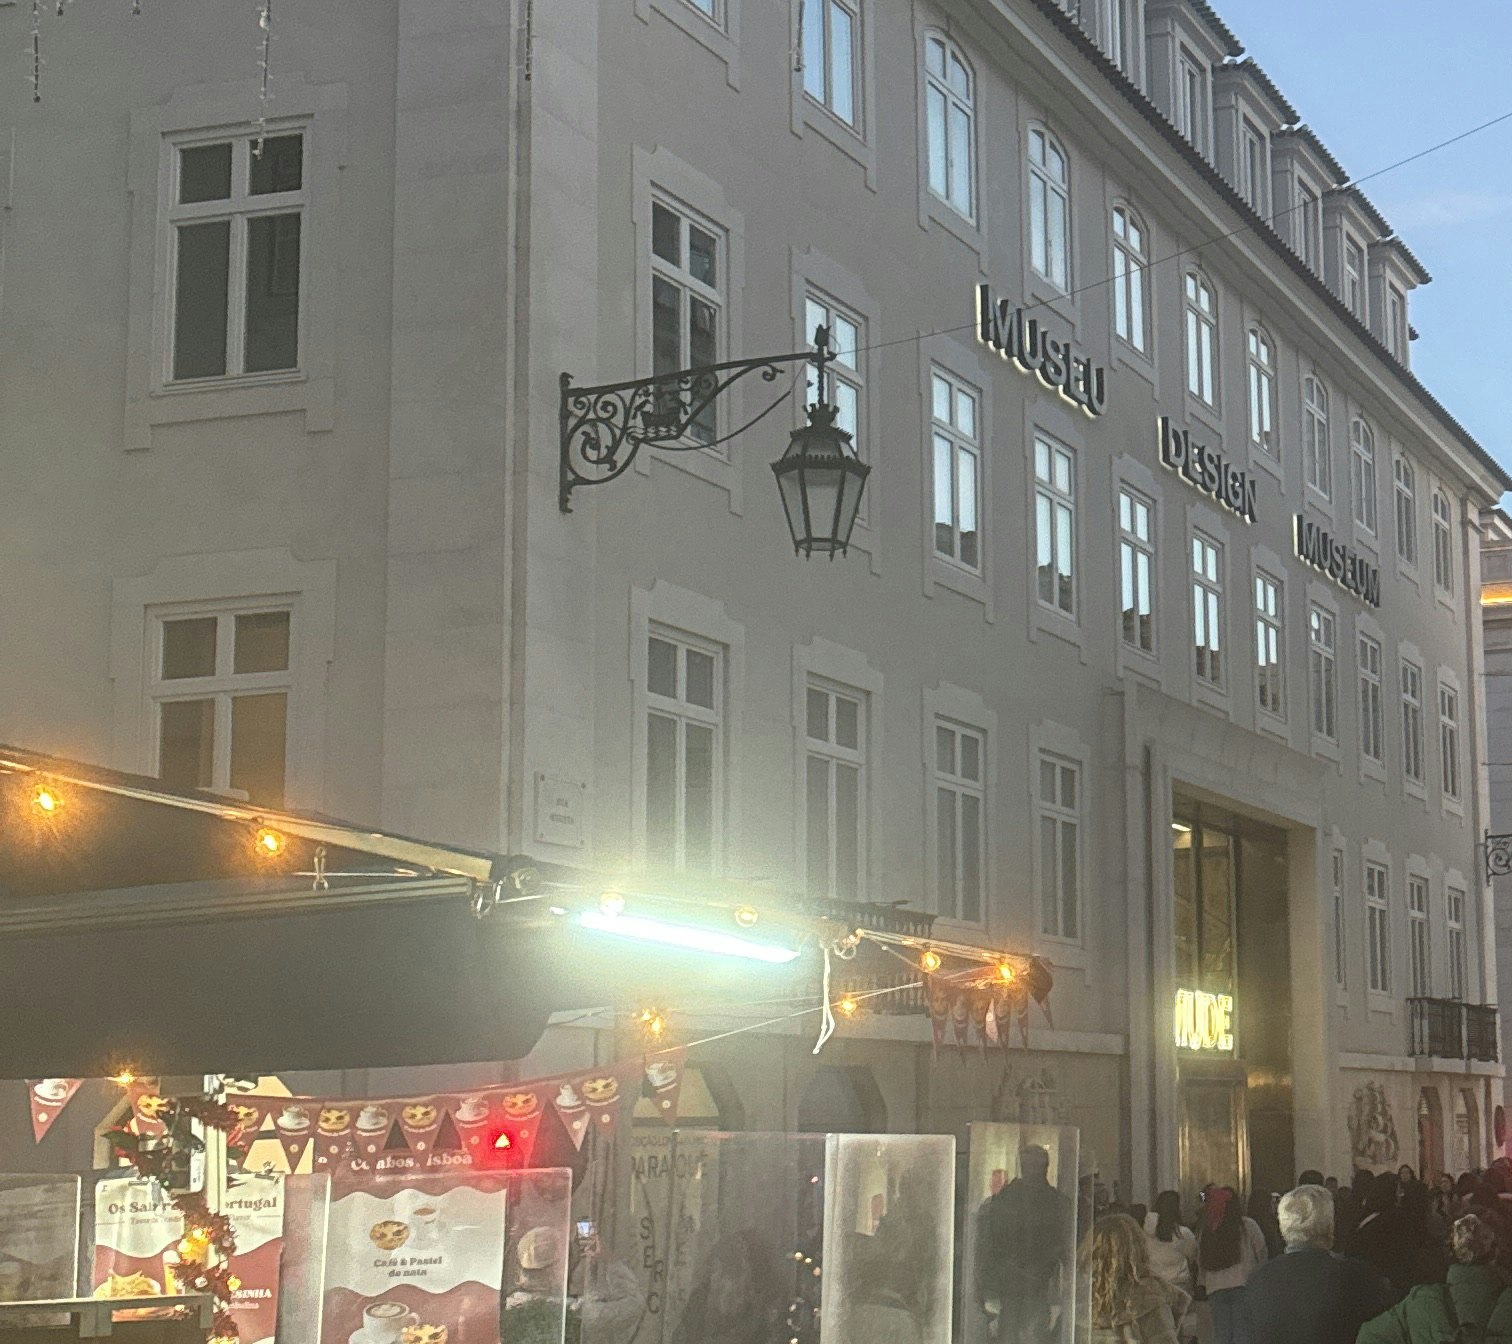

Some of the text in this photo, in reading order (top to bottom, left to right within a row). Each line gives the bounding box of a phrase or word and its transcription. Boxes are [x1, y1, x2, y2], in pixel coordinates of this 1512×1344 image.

[976, 283, 1106, 416] MUSEU
[1157, 416, 1257, 524] DESIGN
[1294, 514, 1381, 608] MUSEUM
[108, 1203, 125, 1215] Os
